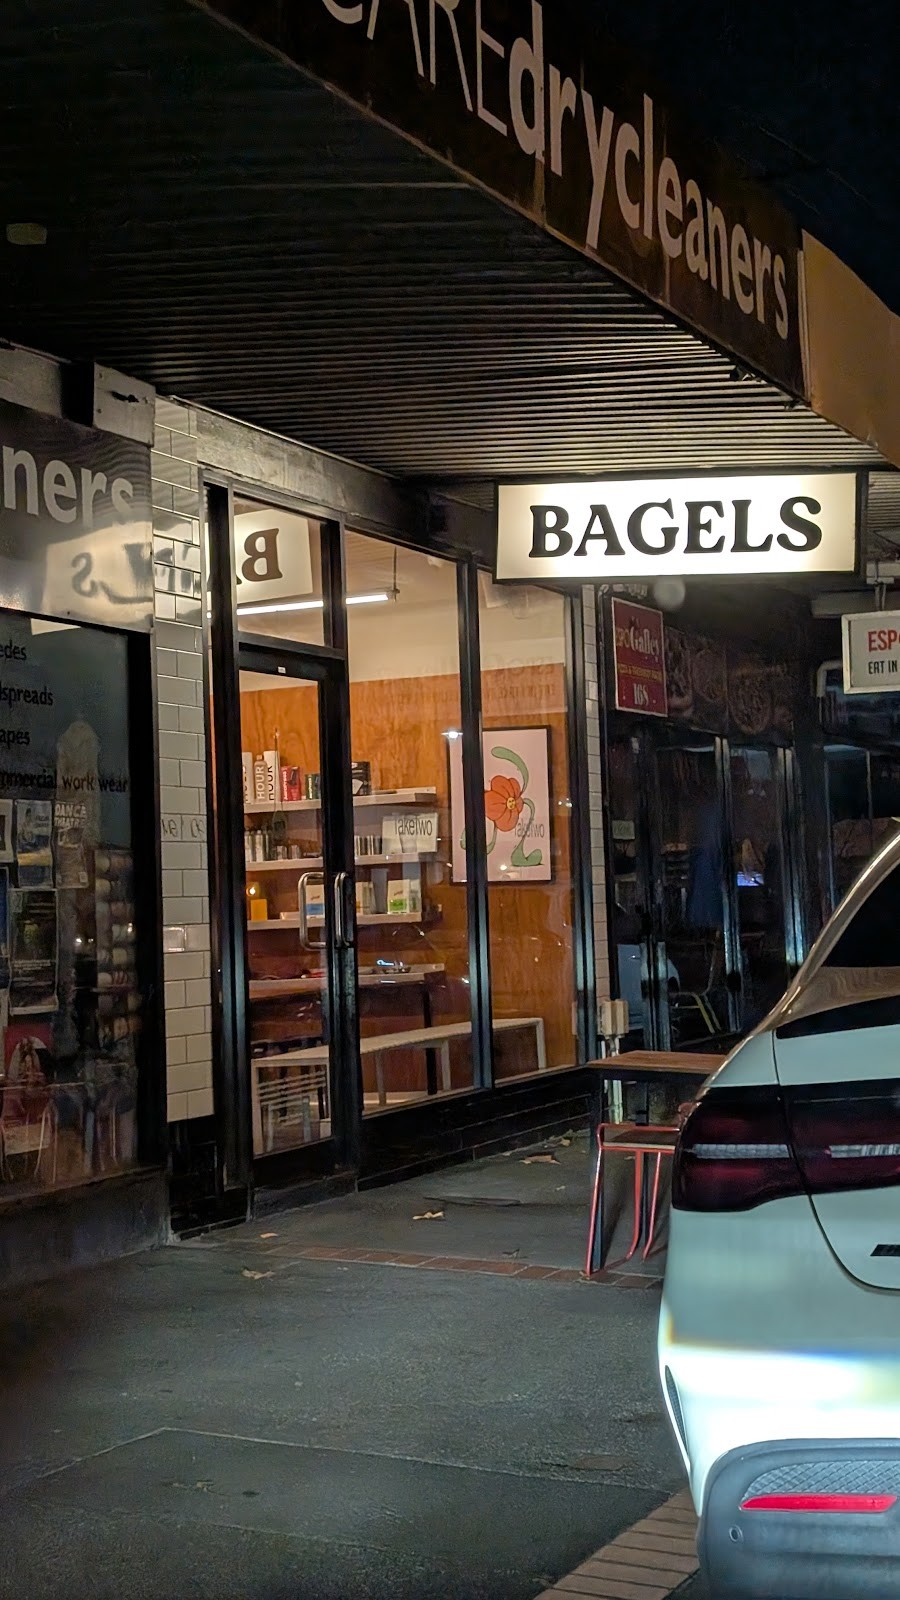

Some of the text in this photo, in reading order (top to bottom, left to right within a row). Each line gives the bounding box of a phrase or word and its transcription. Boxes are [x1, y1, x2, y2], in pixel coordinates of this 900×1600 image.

[528, 495, 823, 558] BAGELS
[867, 629, 900, 652] ESP
[868, 660, 898, 675] EAT IN
[0, 681, 53, 708] spreads
[62, 773, 96, 791] work
